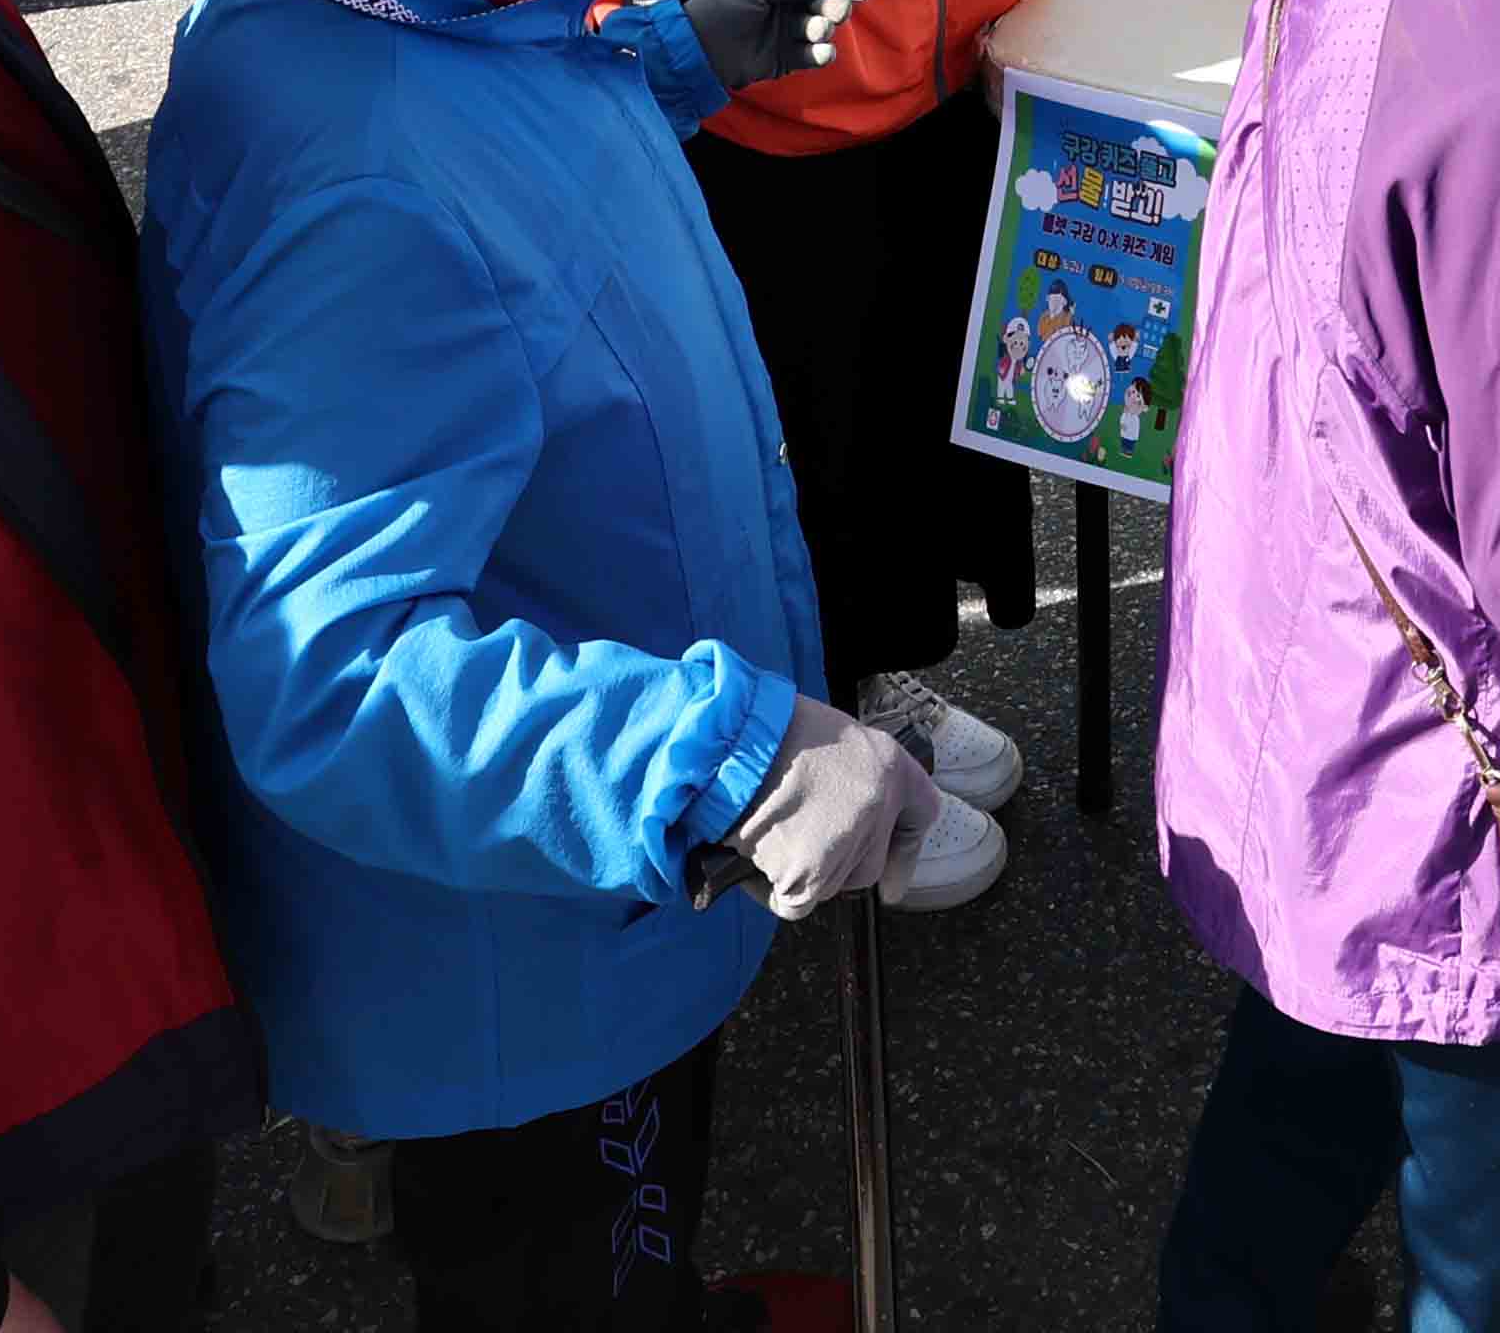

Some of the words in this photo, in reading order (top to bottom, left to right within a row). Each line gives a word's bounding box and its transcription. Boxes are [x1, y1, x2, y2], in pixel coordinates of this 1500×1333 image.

[1060, 130, 1100, 167] 구강
[1100, 139, 1139, 177] 퀴즈
[1138, 149, 1177, 188] 풀고
[1122, 234, 1149, 257] 퀴즈
